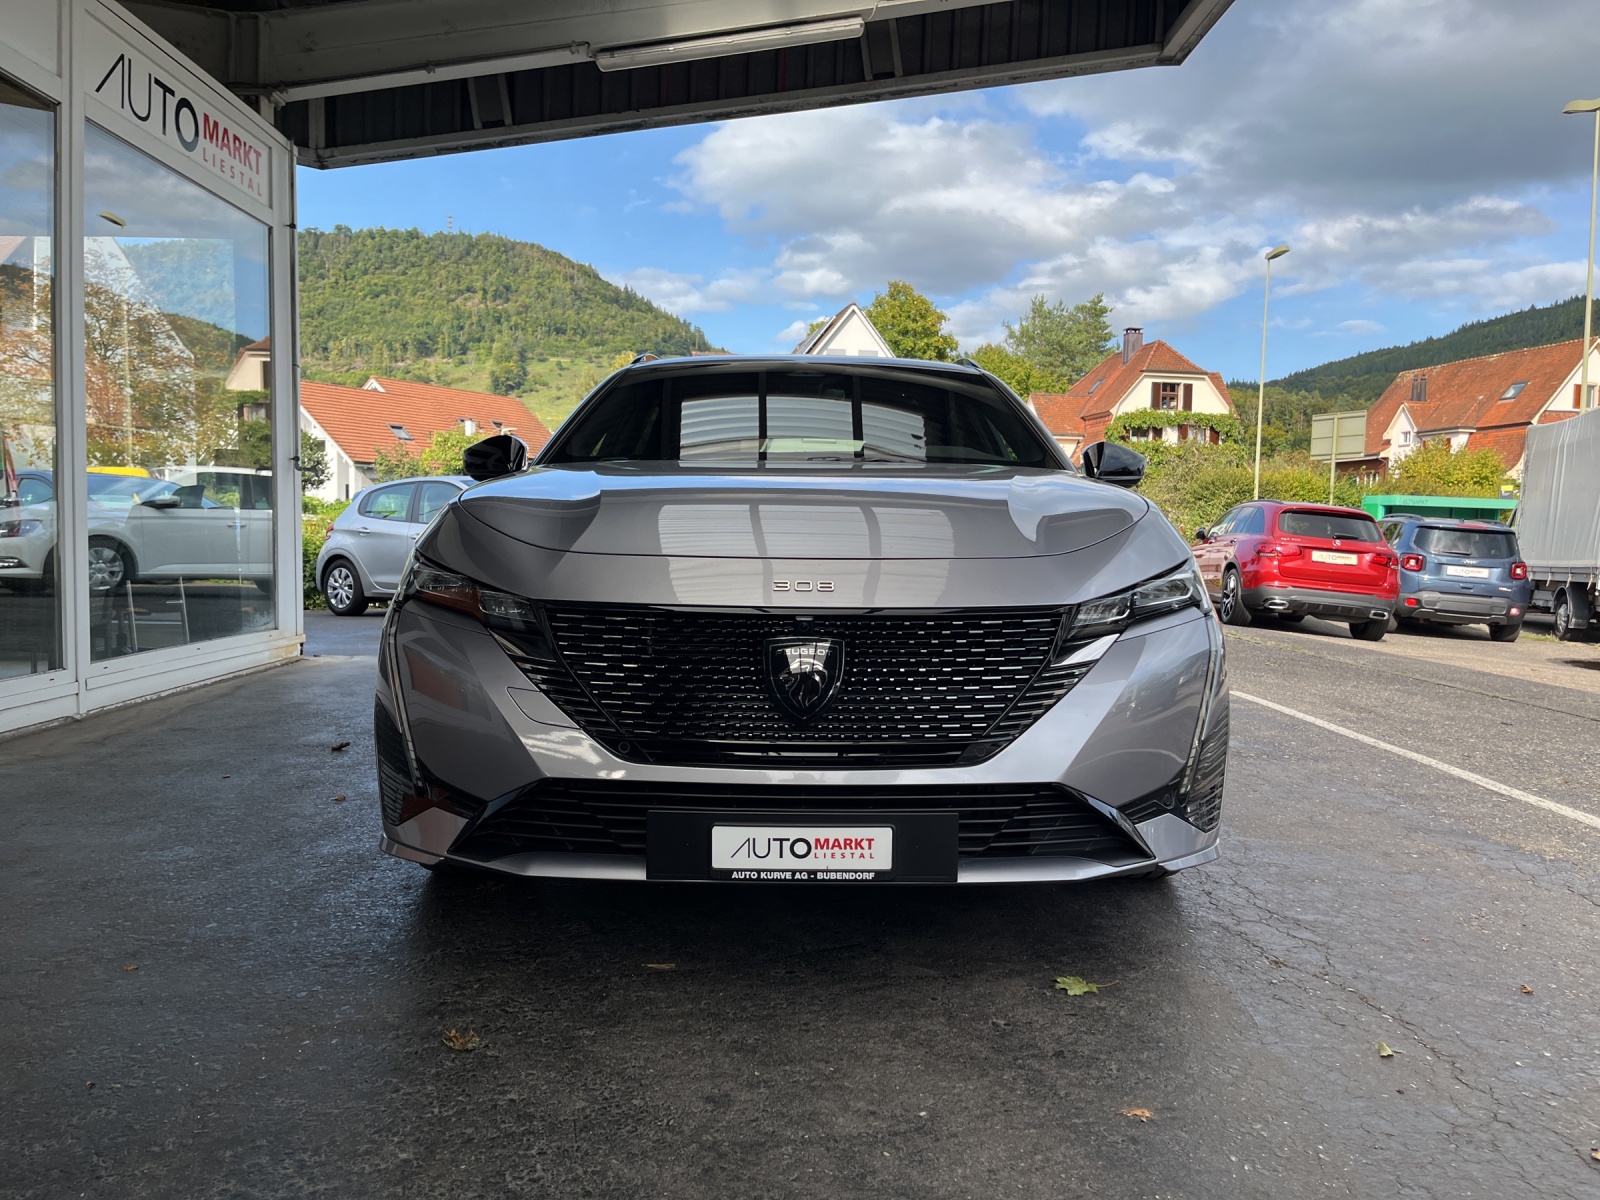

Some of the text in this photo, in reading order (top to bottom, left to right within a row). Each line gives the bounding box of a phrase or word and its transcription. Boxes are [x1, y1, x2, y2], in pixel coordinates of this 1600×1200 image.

[95, 53, 262, 175] AUTO MARKT
[203, 147, 262, 197] LIESTAL
[773, 580, 835, 592] 308
[731, 838, 875, 859] AUTO MARKT
[731, 871, 758, 879] AUTO
[760, 871, 792, 879] KURVE
[794, 872, 808, 880] AG
[817, 872, 875, 880] BUBENDORF
